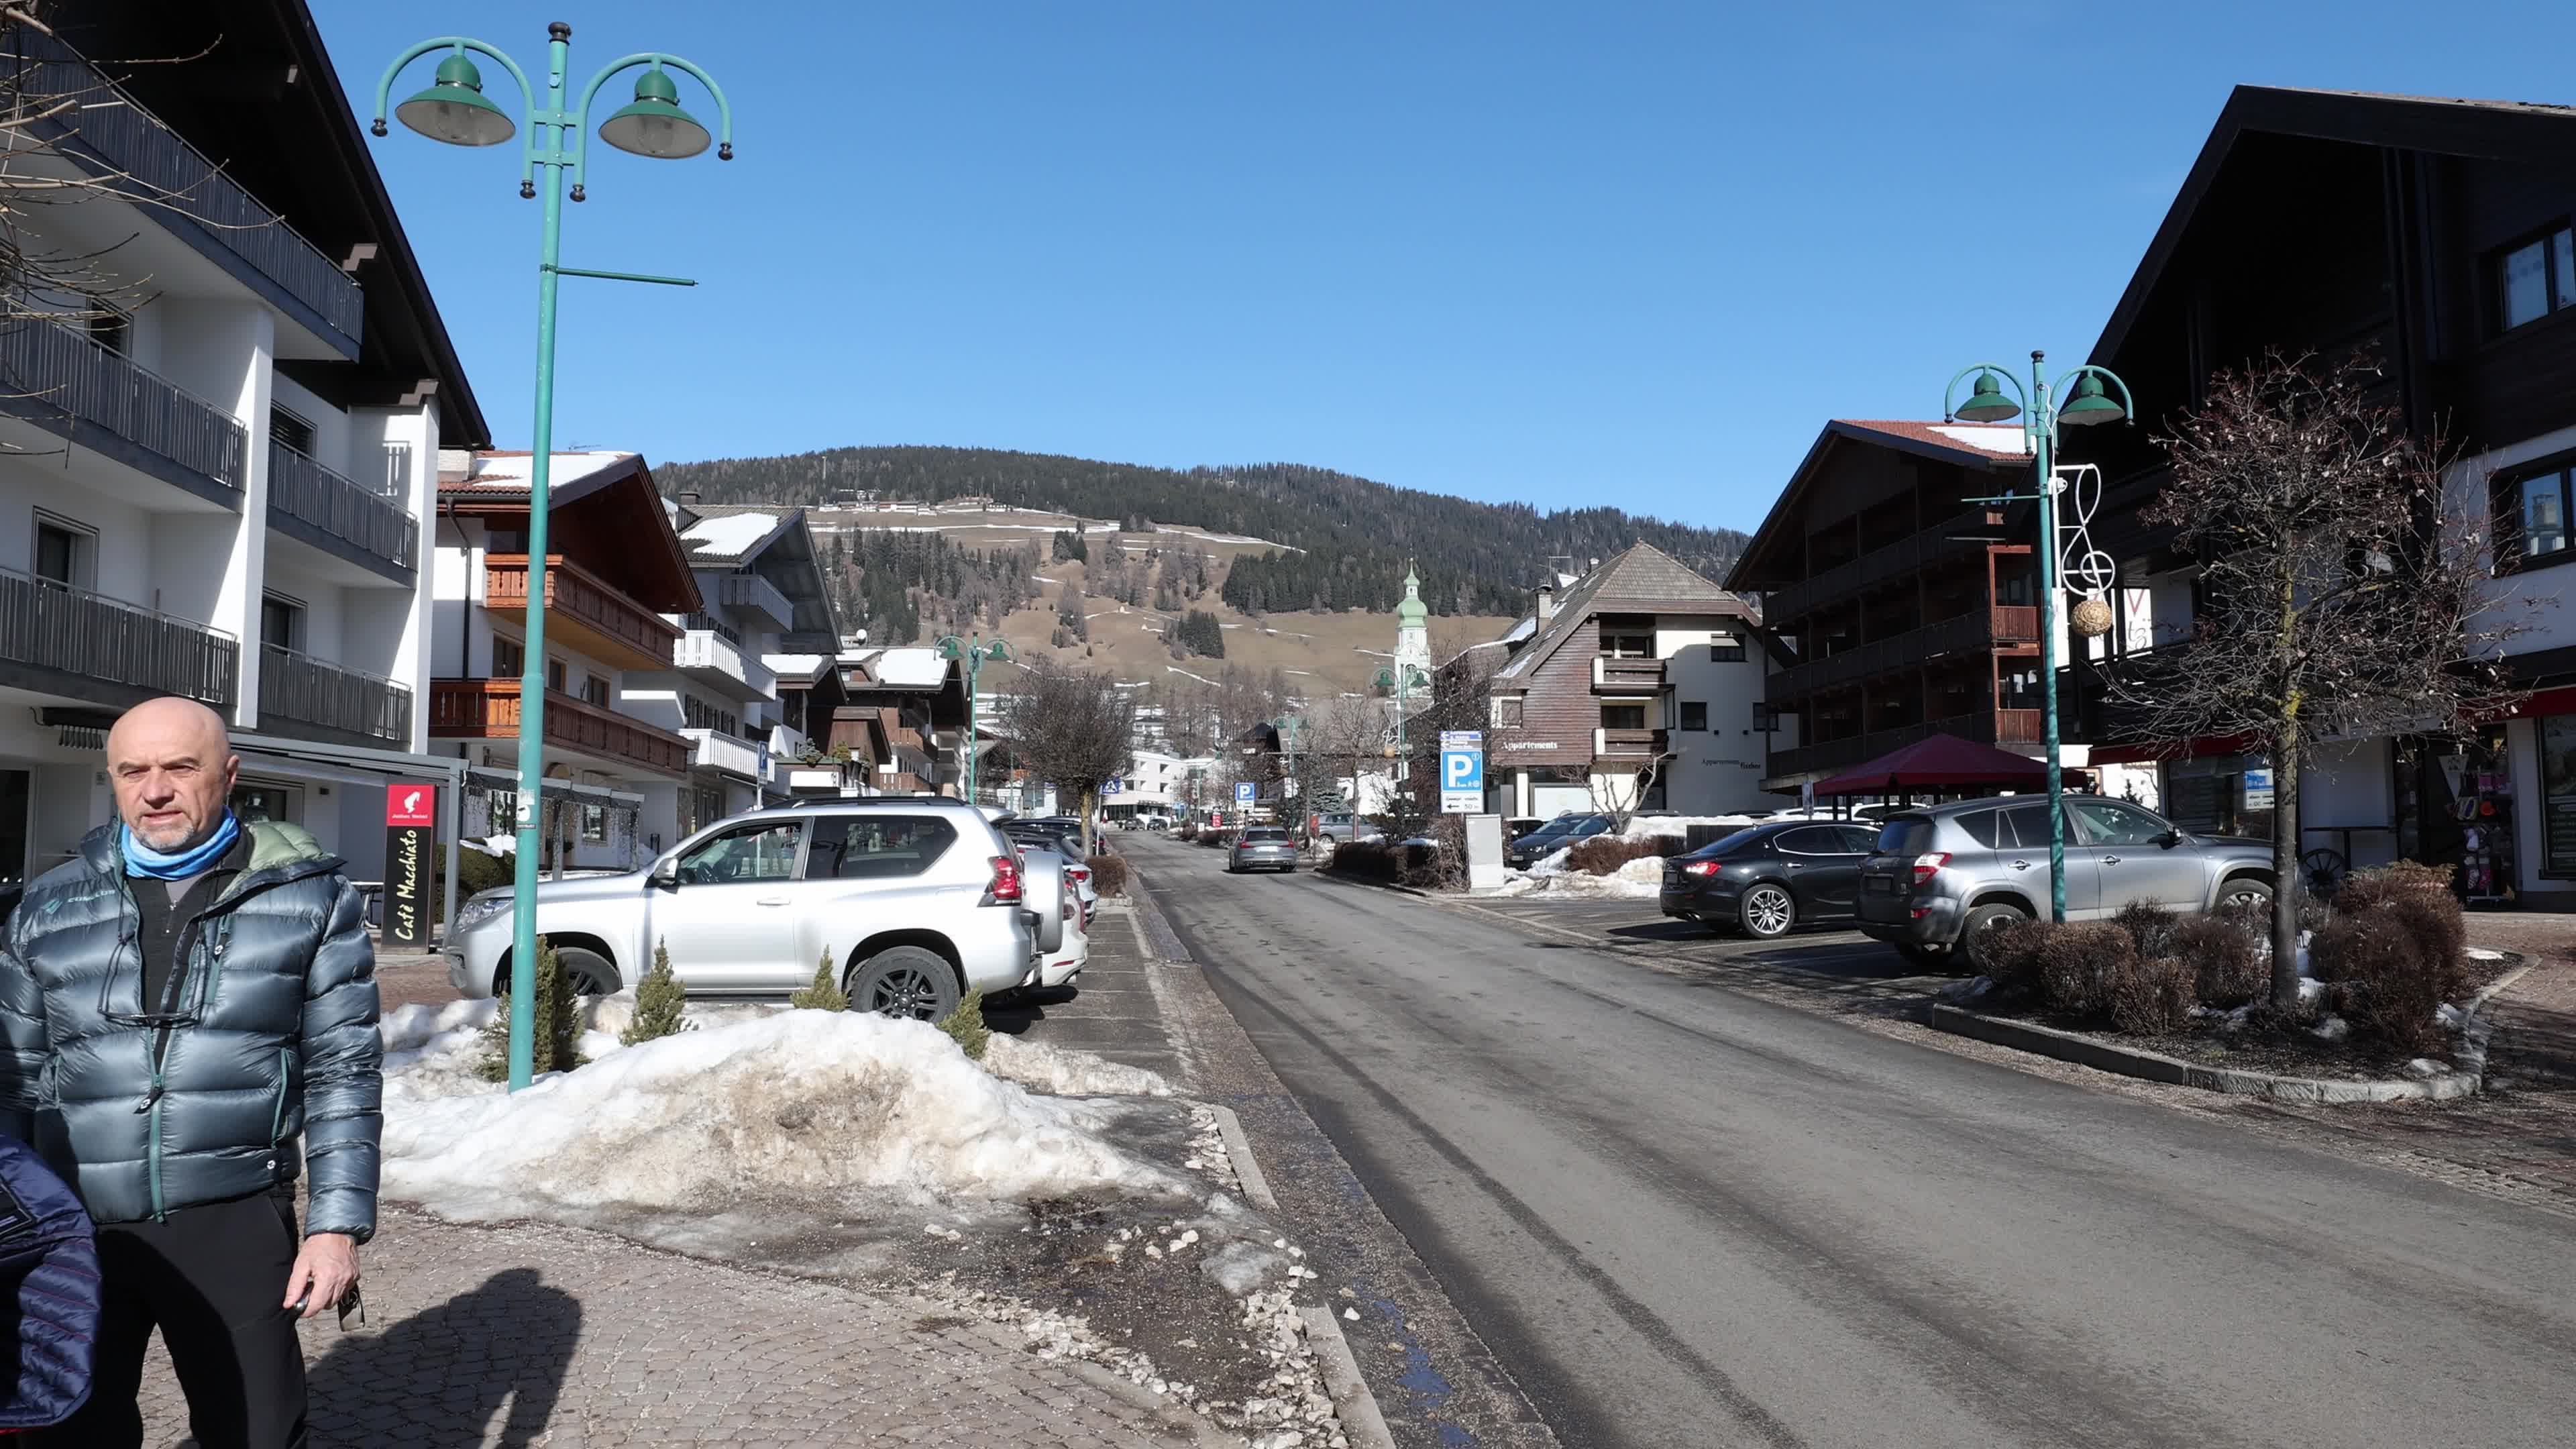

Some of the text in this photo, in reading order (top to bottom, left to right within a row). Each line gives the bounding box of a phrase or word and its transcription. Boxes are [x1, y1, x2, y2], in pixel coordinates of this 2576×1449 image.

[1501, 741, 1558, 751] Appartements
[1448, 755, 1473, 788] P
[1239, 785, 1251, 799] P
[396, 829, 417, 899] Macchiato
